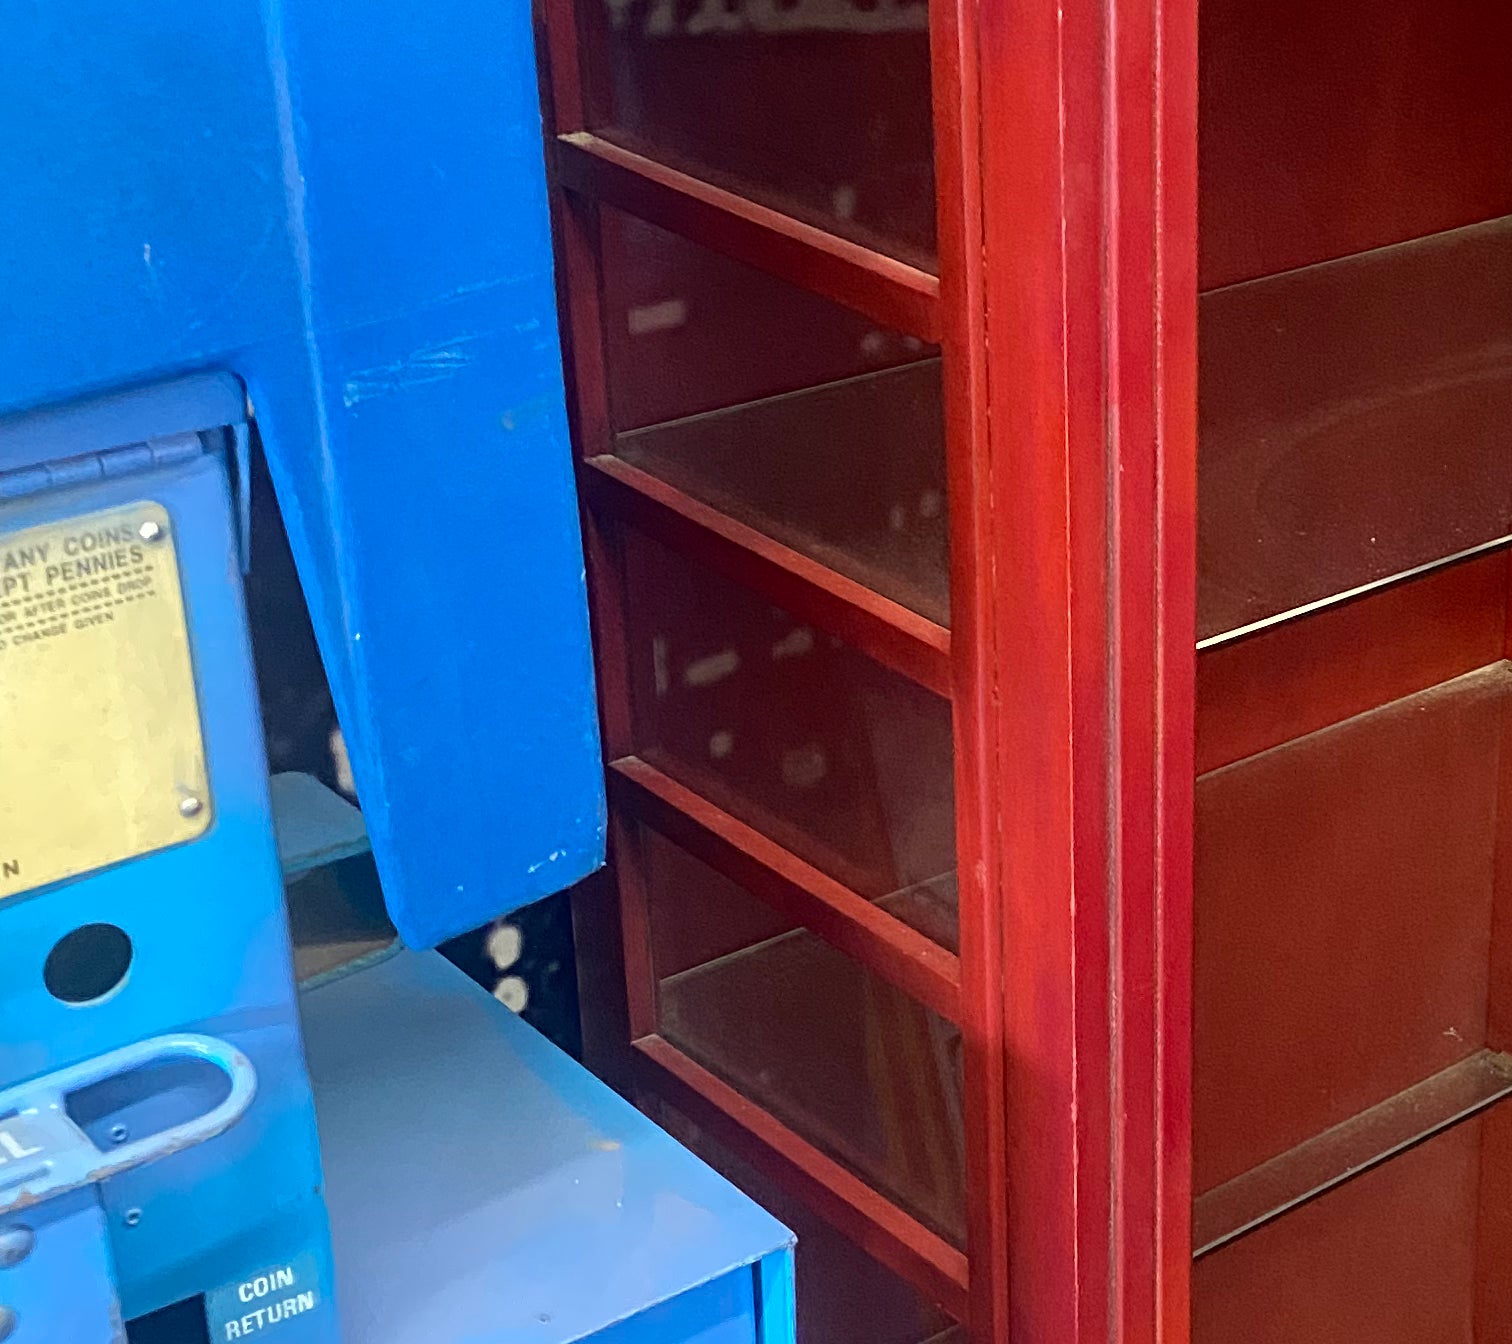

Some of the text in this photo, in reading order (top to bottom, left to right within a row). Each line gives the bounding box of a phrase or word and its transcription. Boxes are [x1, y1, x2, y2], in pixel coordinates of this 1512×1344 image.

[0, 544, 144, 598] PT PENNIES
[3, 524, 134, 572] ANY COINS
[73, 610, 114, 630] GIVEN
[238, 1266, 294, 1304] COIN
[224, 1290, 315, 1342] RETURN
